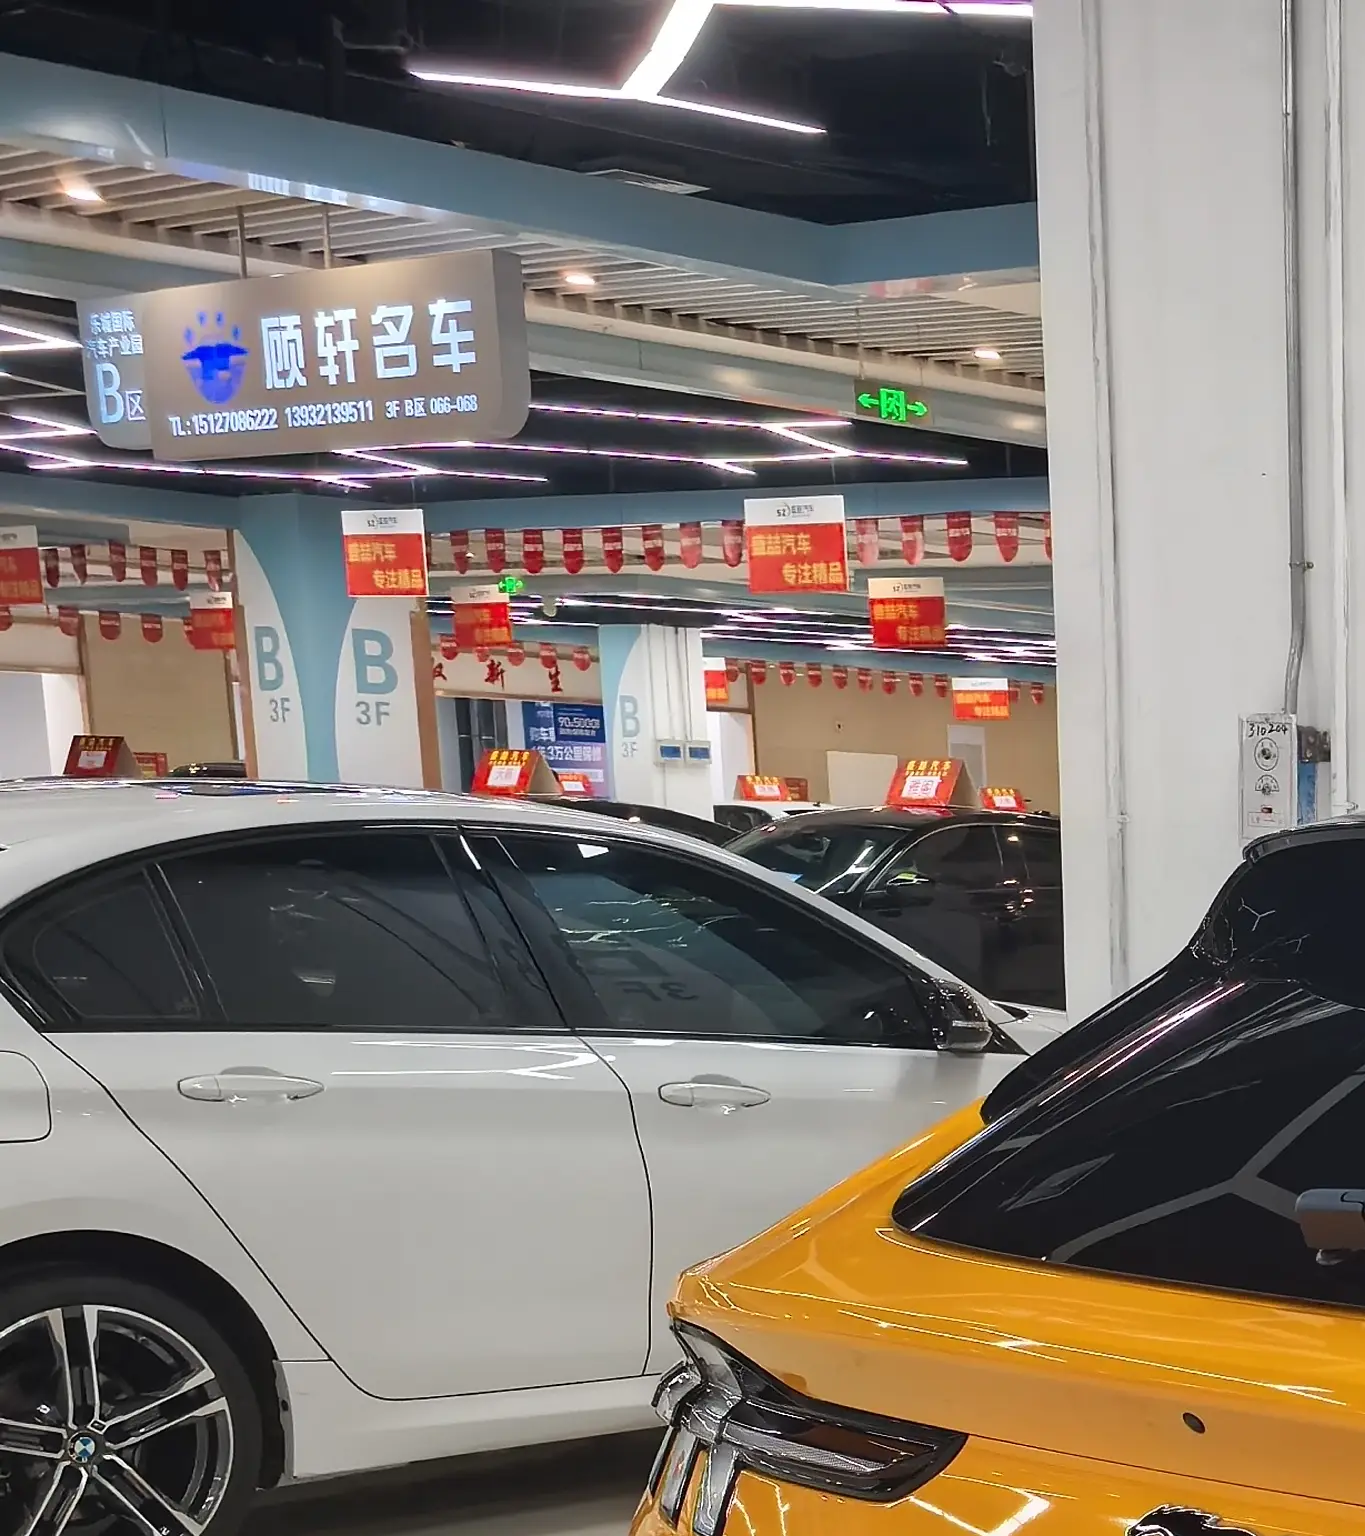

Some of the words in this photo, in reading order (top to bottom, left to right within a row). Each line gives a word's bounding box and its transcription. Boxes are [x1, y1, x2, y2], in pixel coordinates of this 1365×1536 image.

[260, 298, 477, 390] 顾轩名车
[285, 400, 373, 427] 13932139511
[385, 400, 400, 418] 3F
[430, 395, 477, 414] 066-068
[782, 562, 844, 585] 专注精品
[254, 626, 284, 691] B
[351, 628, 399, 695] B
[269, 699, 291, 723] 3F
[355, 701, 390, 725] 3F
[620, 695, 640, 738] B
[622, 742, 638, 758] 3F
